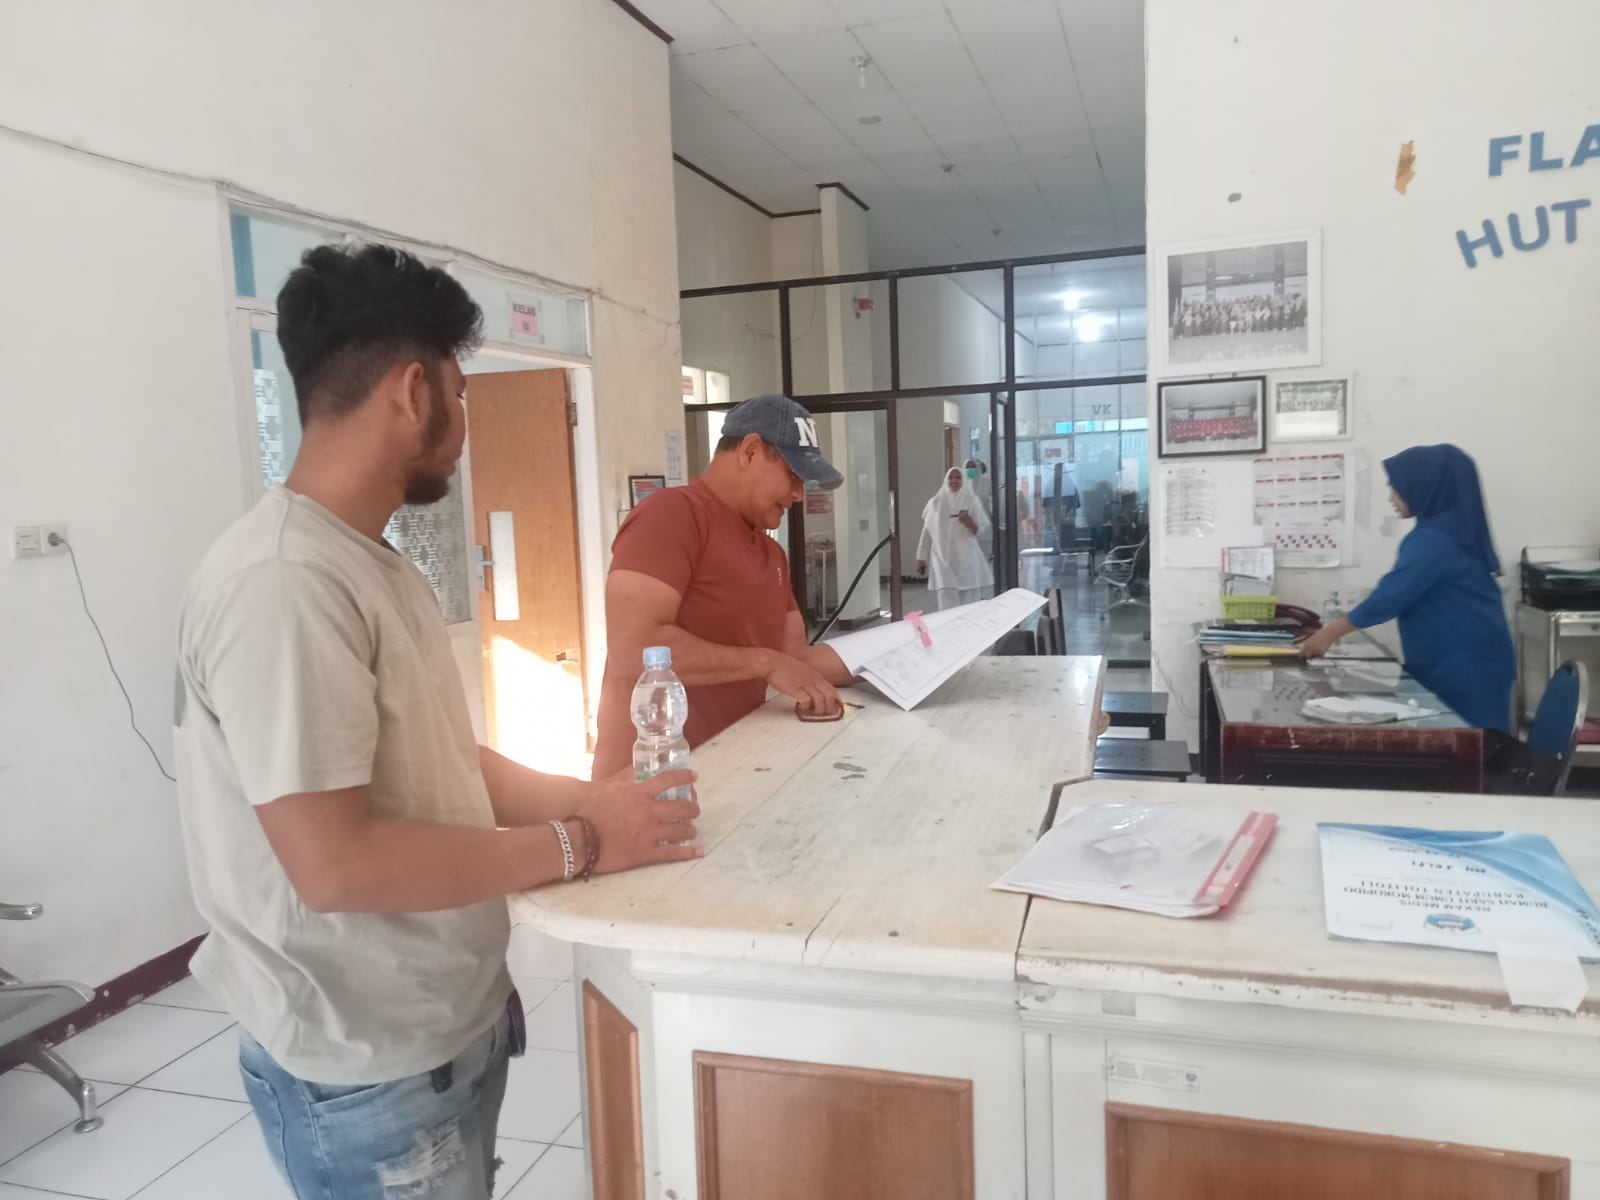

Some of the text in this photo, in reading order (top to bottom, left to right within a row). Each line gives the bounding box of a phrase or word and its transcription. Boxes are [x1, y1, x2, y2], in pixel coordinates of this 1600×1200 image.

[1455, 198, 1592, 270] HUT
[1092, 403, 1111, 416] VK
[794, 416, 819, 448] N
